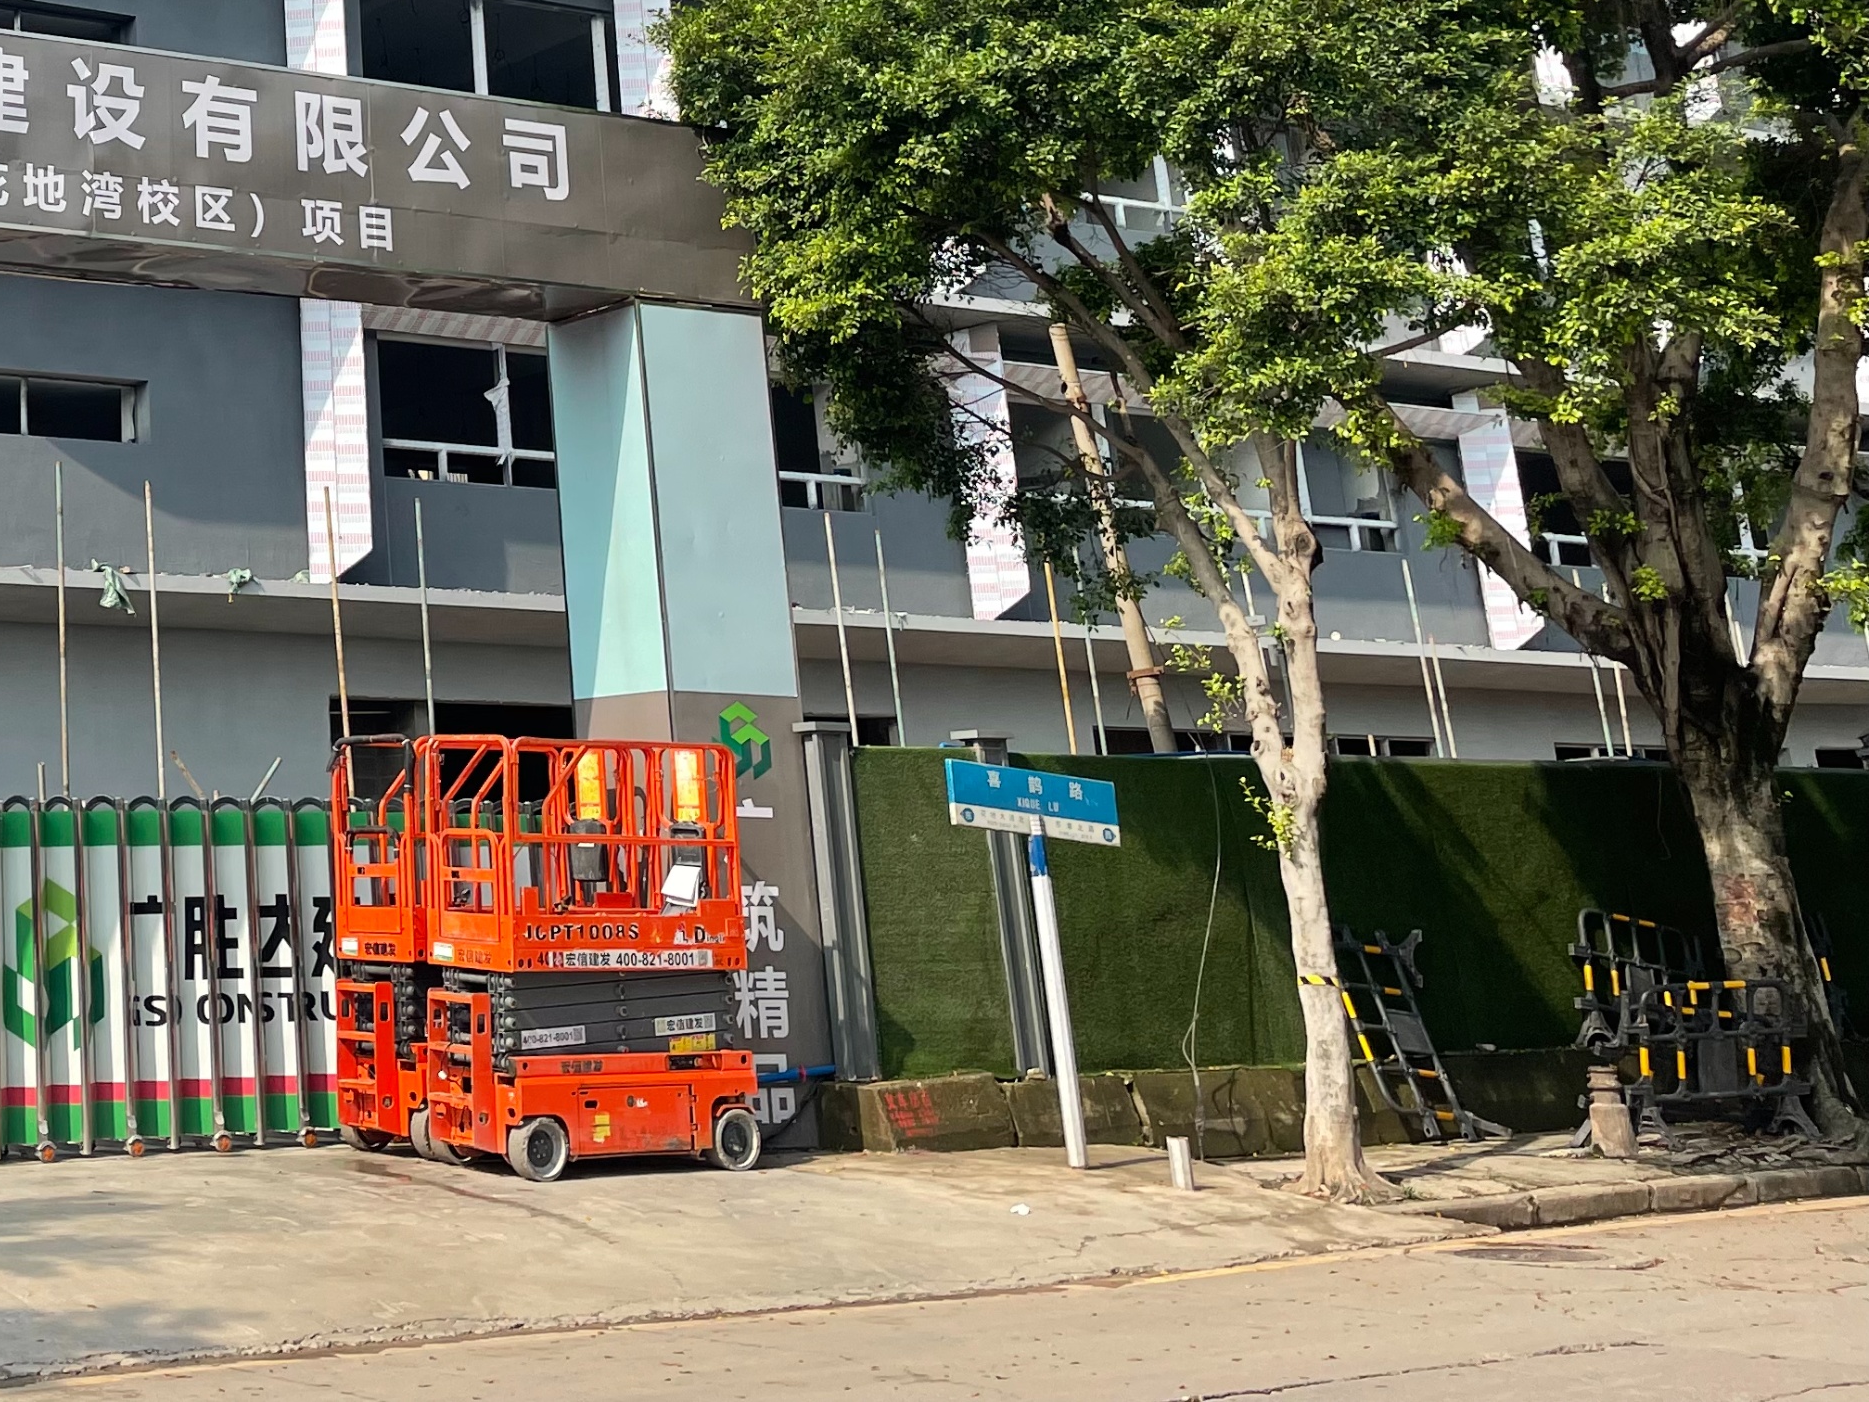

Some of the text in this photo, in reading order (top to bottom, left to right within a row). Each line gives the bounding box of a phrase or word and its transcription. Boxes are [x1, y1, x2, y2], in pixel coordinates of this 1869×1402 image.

[986, 769, 1083, 801] 喜鹊路
[1017, 797, 1059, 813] XIQUE LU
[565, 952, 611, 967] 宏信建发
[616, 952, 694, 967] 400-821-8001
